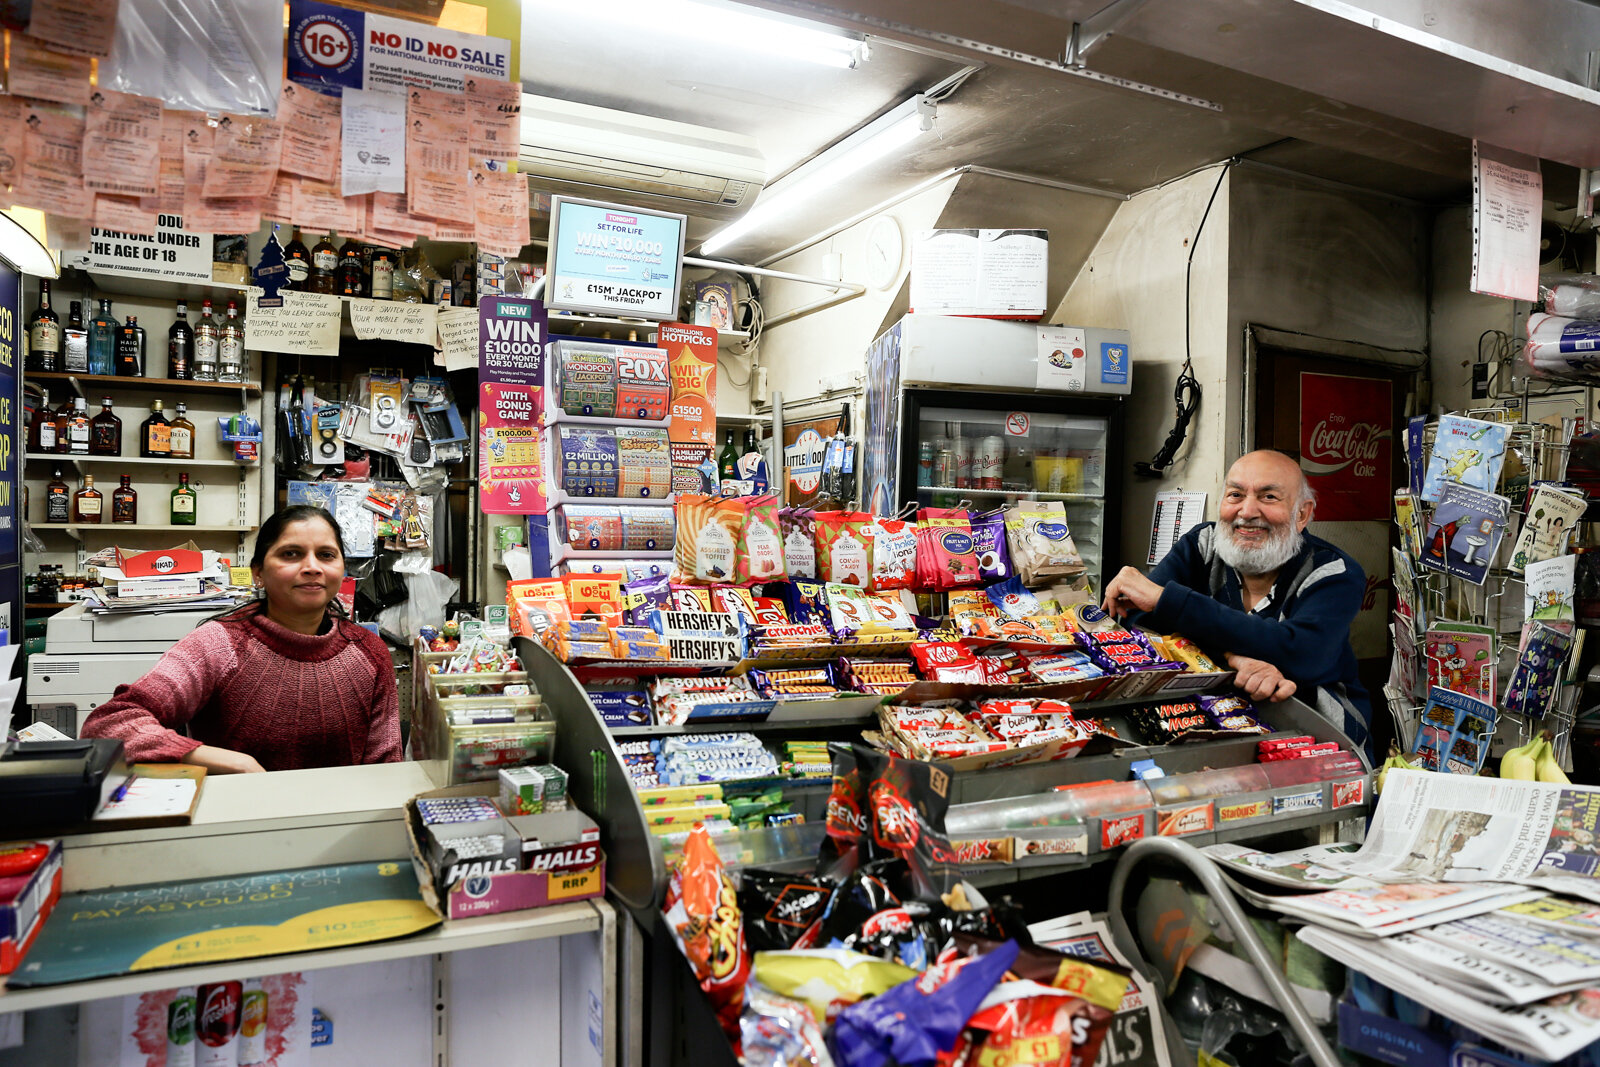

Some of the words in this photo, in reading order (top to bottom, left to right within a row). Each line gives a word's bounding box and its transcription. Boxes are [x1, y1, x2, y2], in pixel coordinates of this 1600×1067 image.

[306, 32, 348, 57] 16+
[370, 30, 402, 48] NO
[405, 37, 424, 52] ID
[427, 41, 458, 59] NO
[461, 48, 505, 68] SALE
[370, 46, 386, 54] FOR
[388, 49, 427, 62] NATIONAL
[428, 58, 462, 68] LOTTERY
[464, 64, 505, 76] PRODUCTS
[370, 70, 402, 78] someone
[409, 70, 437, 80] National
[438, 76, 464, 85] Lottery
[374, 77, 404, 87] criminal
[608, 214, 634, 223] TONIGHT
[157, 232, 200, 248] UNDER
[577, 231, 608, 250] WIN
[611, 236, 663, 256] £10,000
[114, 245, 140, 258] AGE
[143, 248, 158, 260] OF
[162, 250, 176, 262] 18
[617, 288, 662, 300] JACKPOT
[620, 296, 644, 304] FRIDAY
[380, 304, 404, 314] SWITCH
[501, 306, 527, 316] NEW
[442, 330, 462, 338] forged
[486, 318, 540, 343] WIN
[662, 327, 704, 336] EUROMILLIONS
[662, 332, 712, 346] HOTPICKS
[485, 341, 541, 356] £10,000
[566, 364, 612, 372] MONOPOLY
[619, 357, 667, 381] 20X
[674, 365, 702, 376] WIN
[678, 377, 700, 388] BIG
[500, 391, 528, 400] WITH
[496, 400, 532, 410] BONUS
[672, 405, 702, 416] £1500
[318, 410, 339, 418] LYPSYL
[498, 411, 530, 420] GAME
[1330, 413, 1346, 424] Enjoy
[620, 440, 658, 452] Bingo
[1309, 420, 1379, 461] Coca-Cola
[577, 452, 615, 461] MILLION
[1354, 461, 1376, 477] Coke
[152, 560, 178, 570] MIKADO
[582, 586, 592, 597] 6
[598, 583, 611, 601] £1
[634, 594, 643, 602] £1
[986, 608, 997, 616] £1
[667, 613, 732, 631] HERSHEY'S
[669, 638, 736, 661] HERSHEY'S
[1528, 650, 1555, 669] YOUR
[765, 670, 826, 685] YORKIE
[852, 664, 909, 676] YORKIE
[674, 678, 732, 688] BOUNTY
[859, 674, 916, 684] YORKIE
[1432, 690, 1460, 703] Happy
[906, 708, 933, 716] bueno
[1159, 702, 1196, 718] Mars
[1008, 715, 1036, 730] bueno
[1167, 714, 1206, 733] Mars
[926, 730, 953, 738] bueno
[688, 750, 750, 761] BOUNTY
[694, 758, 756, 772] BOUNTY
[934, 774, 945, 791] £1
[1524, 789, 1540, 821] exams
[1540, 790, 1557, 812] Now
[1574, 792, 1590, 810] TV
[1178, 815, 1207, 833] Galaxy
[1220, 803, 1257, 820] Starburst
[1583, 792, 1600, 832] Binge
[1537, 814, 1551, 828] it's
[1517, 822, 1532, 841] and
[1531, 830, 1547, 847] the
[532, 846, 597, 871] HALLS
[1506, 842, 1525, 863] shuts
[447, 857, 518, 884] HALLS
[200, 874, 280, 890] GIVES
[270, 882, 294, 892] £1
[302, 877, 341, 888] ON
[563, 877, 588, 890] RRP
[71, 906, 130, 922] PAY
[135, 902, 176, 915] AS
[180, 895, 243, 910] YOU
[248, 890, 292, 902] GO
[308, 923, 347, 934] £10
[1060, 975, 1086, 993] £1
[1361, 1025, 1424, 1054] ORIGINAL
[1033, 1042, 1049, 1057] £1
